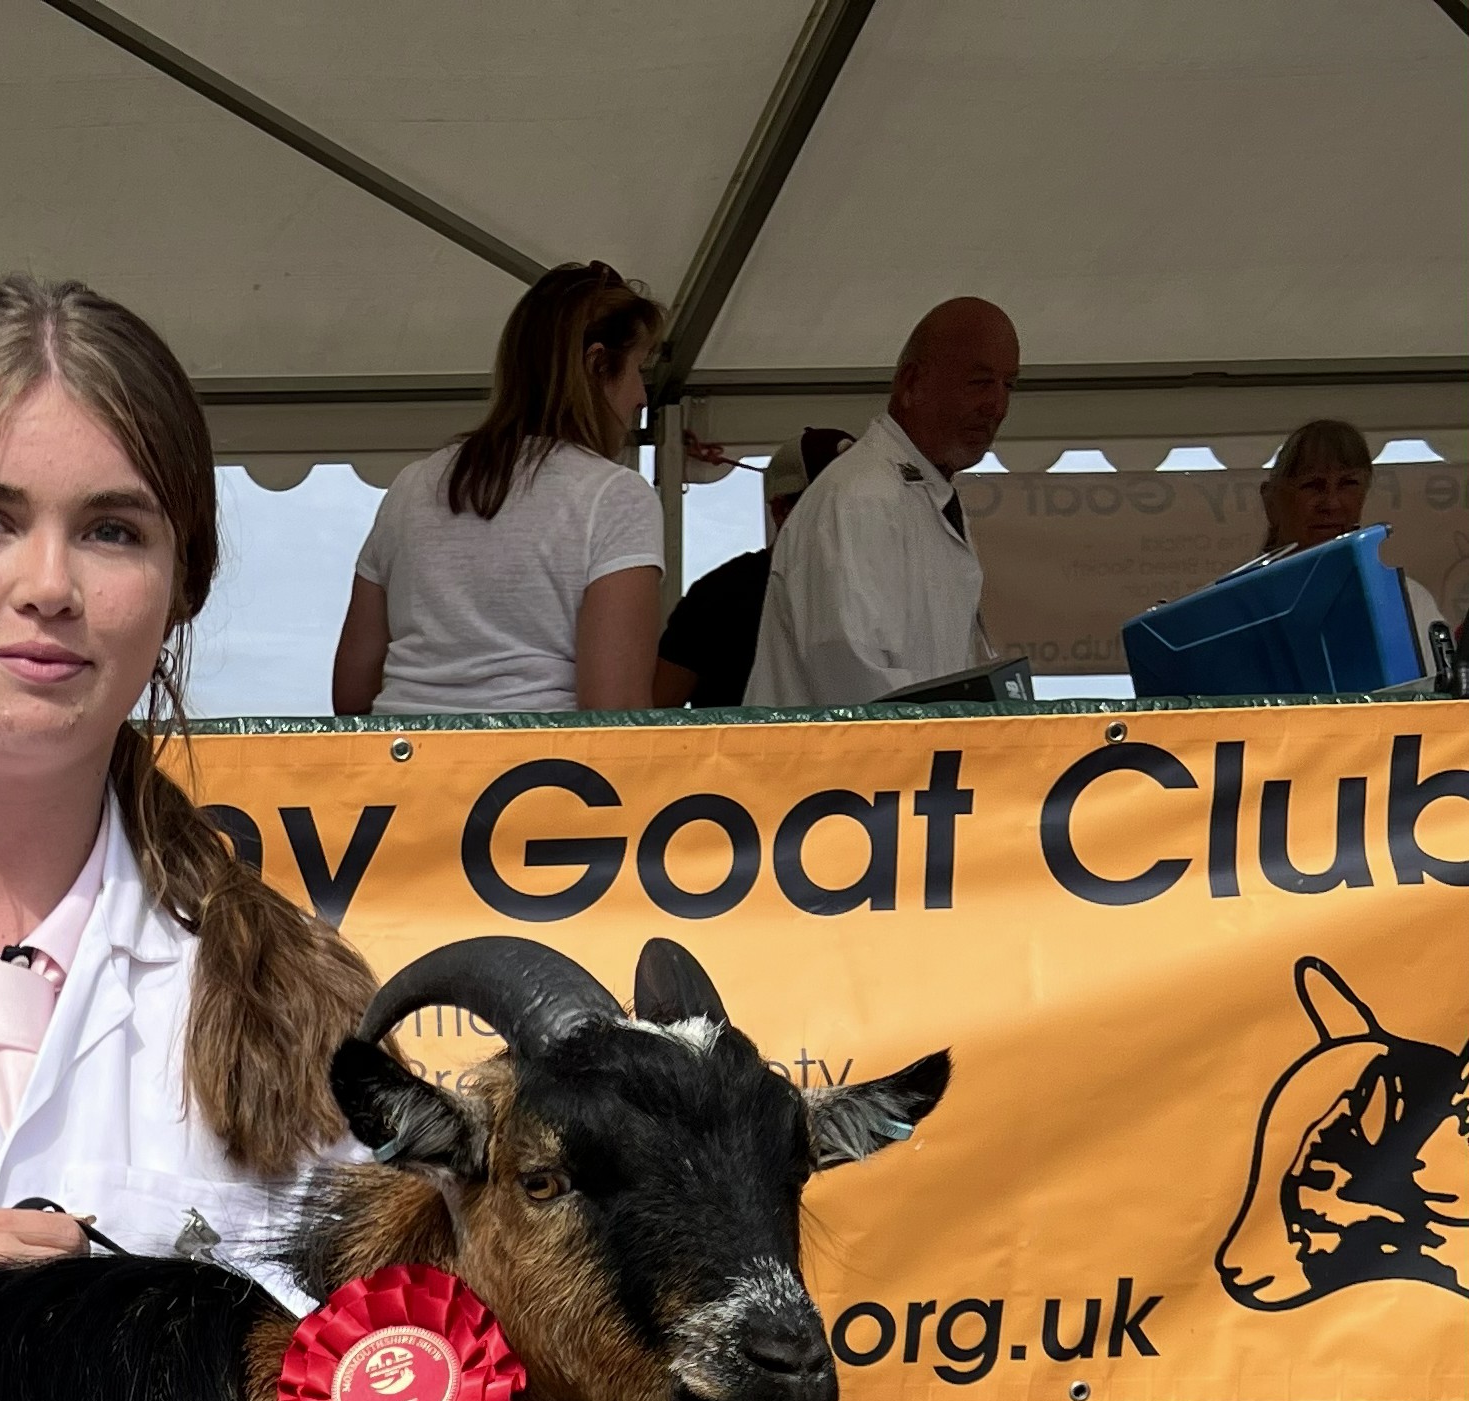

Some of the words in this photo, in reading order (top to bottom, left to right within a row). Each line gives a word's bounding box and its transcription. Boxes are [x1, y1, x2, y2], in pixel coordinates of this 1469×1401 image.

[461, 750, 974, 922] Goat
[1040, 734, 1469, 907] Club
[341, 1335, 416, 1393] MONMOUTHSHIRE
[417, 1337, 443, 1361] SHOW
[830, 1276, 1165, 1385] org.uk
